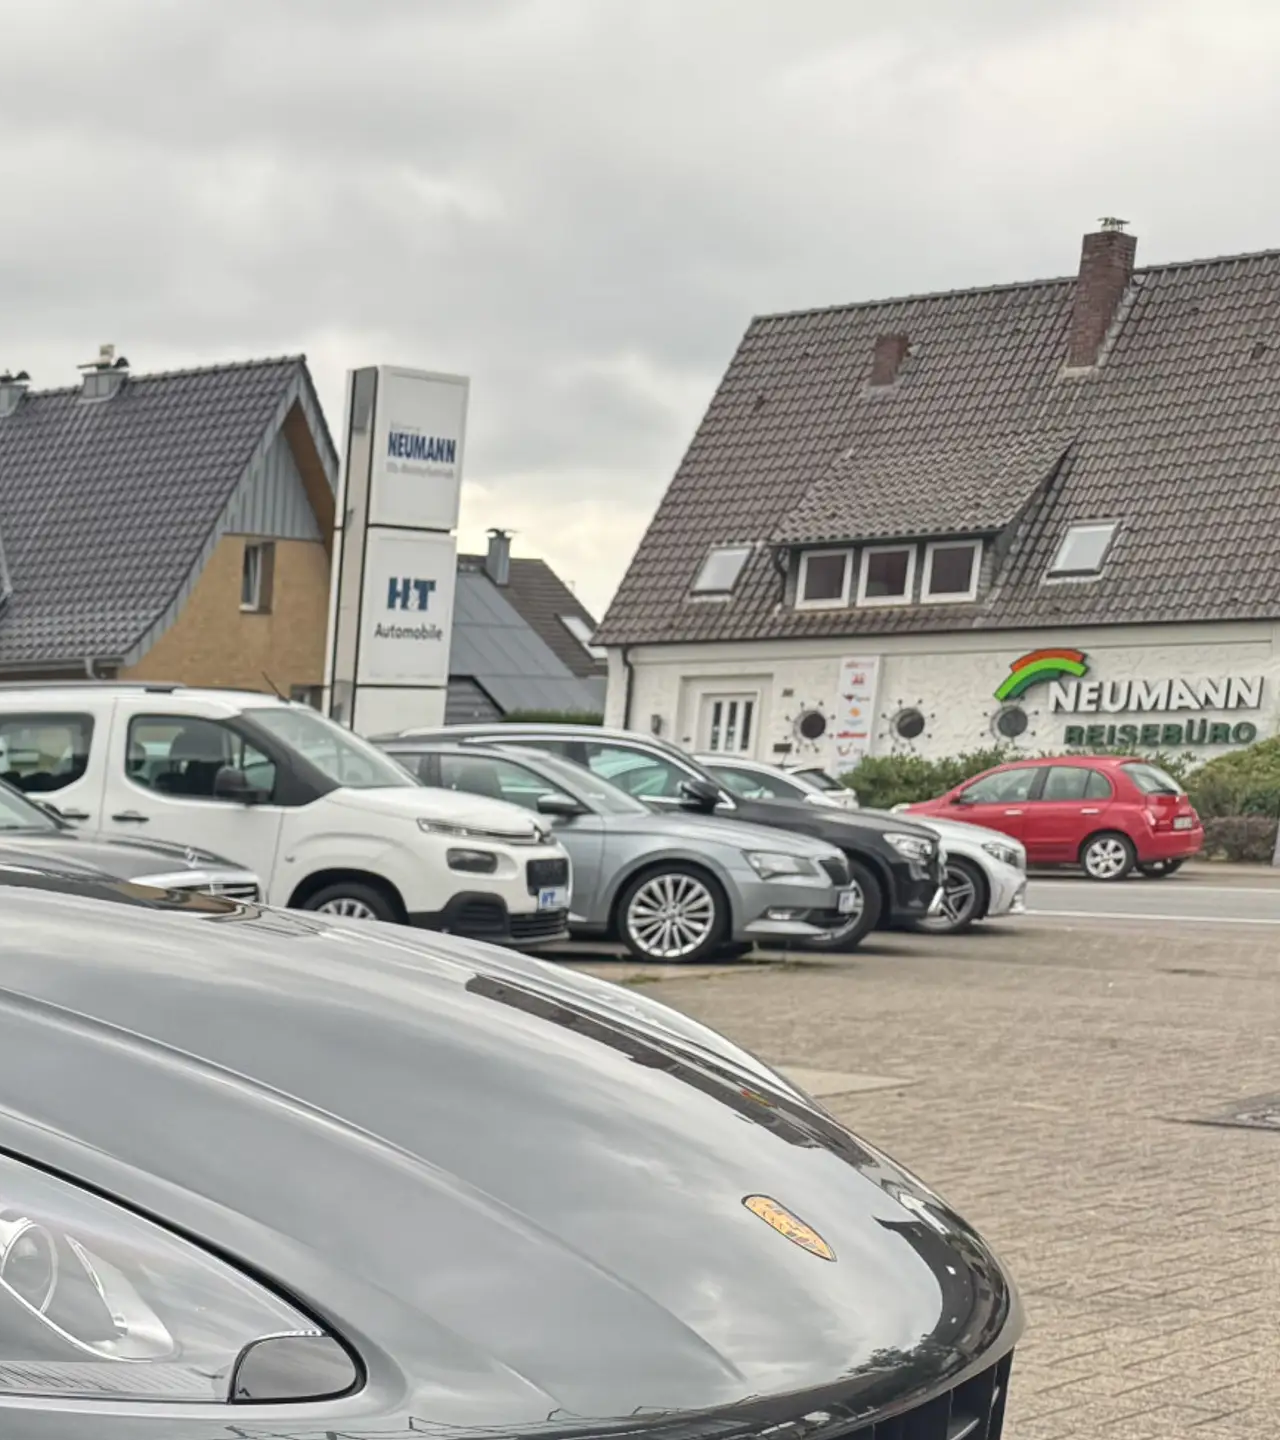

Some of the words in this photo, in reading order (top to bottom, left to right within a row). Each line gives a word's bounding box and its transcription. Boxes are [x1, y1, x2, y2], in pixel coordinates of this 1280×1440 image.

[387, 431, 456, 463] NEUMANN
[374, 622, 443, 642] Automobile
[1048, 676, 1264, 713] NEUMANN
[1063, 718, 1258, 747] REISEBÜRO
